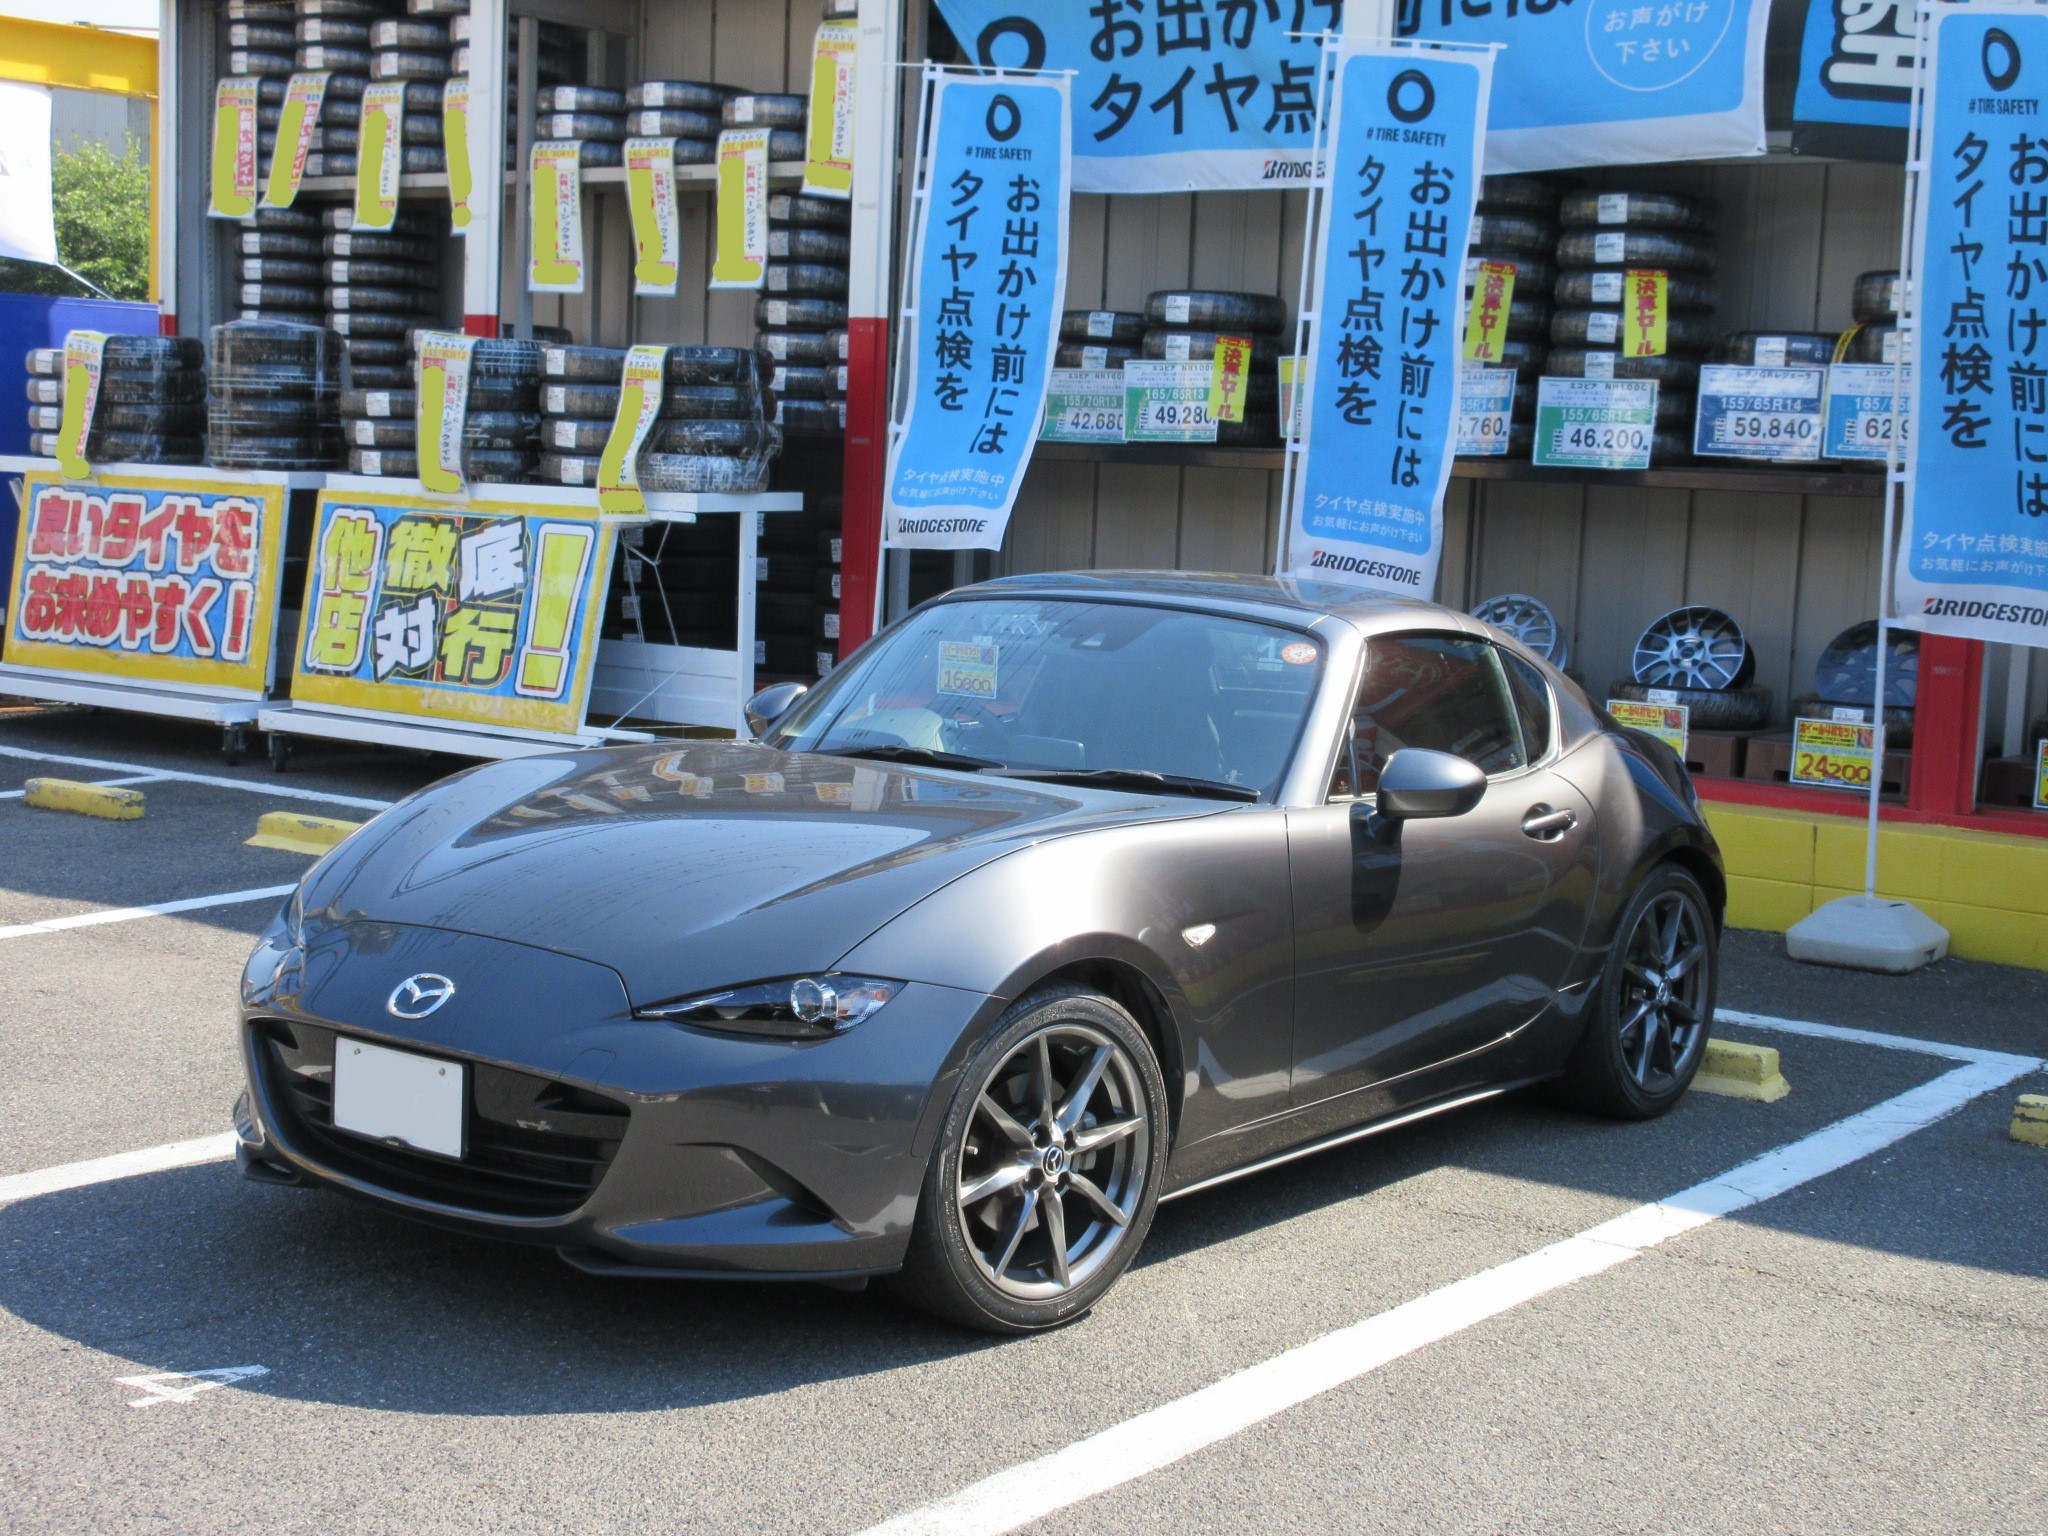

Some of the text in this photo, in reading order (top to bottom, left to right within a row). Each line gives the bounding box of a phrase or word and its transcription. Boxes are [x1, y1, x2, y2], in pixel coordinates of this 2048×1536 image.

[1604, 1, 1706, 32] お声がけ
[1615, 37, 1689, 65] 下さい
[1090, 60, 1336, 143] タイヤ点
[1997, 99, 2038, 115] SAFETY
[999, 148, 1032, 161] SAFETY
[1403, 129, 1446, 147] SAFETY
[1262, 160, 1327, 180] BRIDGE
[934, 169, 984, 411] タイヤ点検を
[1335, 155, 1386, 426] タイヤ点検を
[1940, 131, 1994, 449] タイヤ点検を
[968, 173, 1040, 454] お出かけ前には
[1391, 160, 1455, 488] お出かけ前には
[2005, 132, 2048, 519] お出かけ前には
[903, 468, 1005, 487] タイヤ点検実施中
[898, 518, 988, 533] BRIDGESTONE
[1314, 493, 1426, 527] タイヤ点検実施中
[31, 494, 254, 573] 良いタイヤを
[1312, 515, 1424, 543] お気軽にお声がけ下さい
[1311, 550, 1421, 586] BRIDGESTONE
[310, 515, 378, 666] 他店
[1799, 753, 1871, 782] 24200
